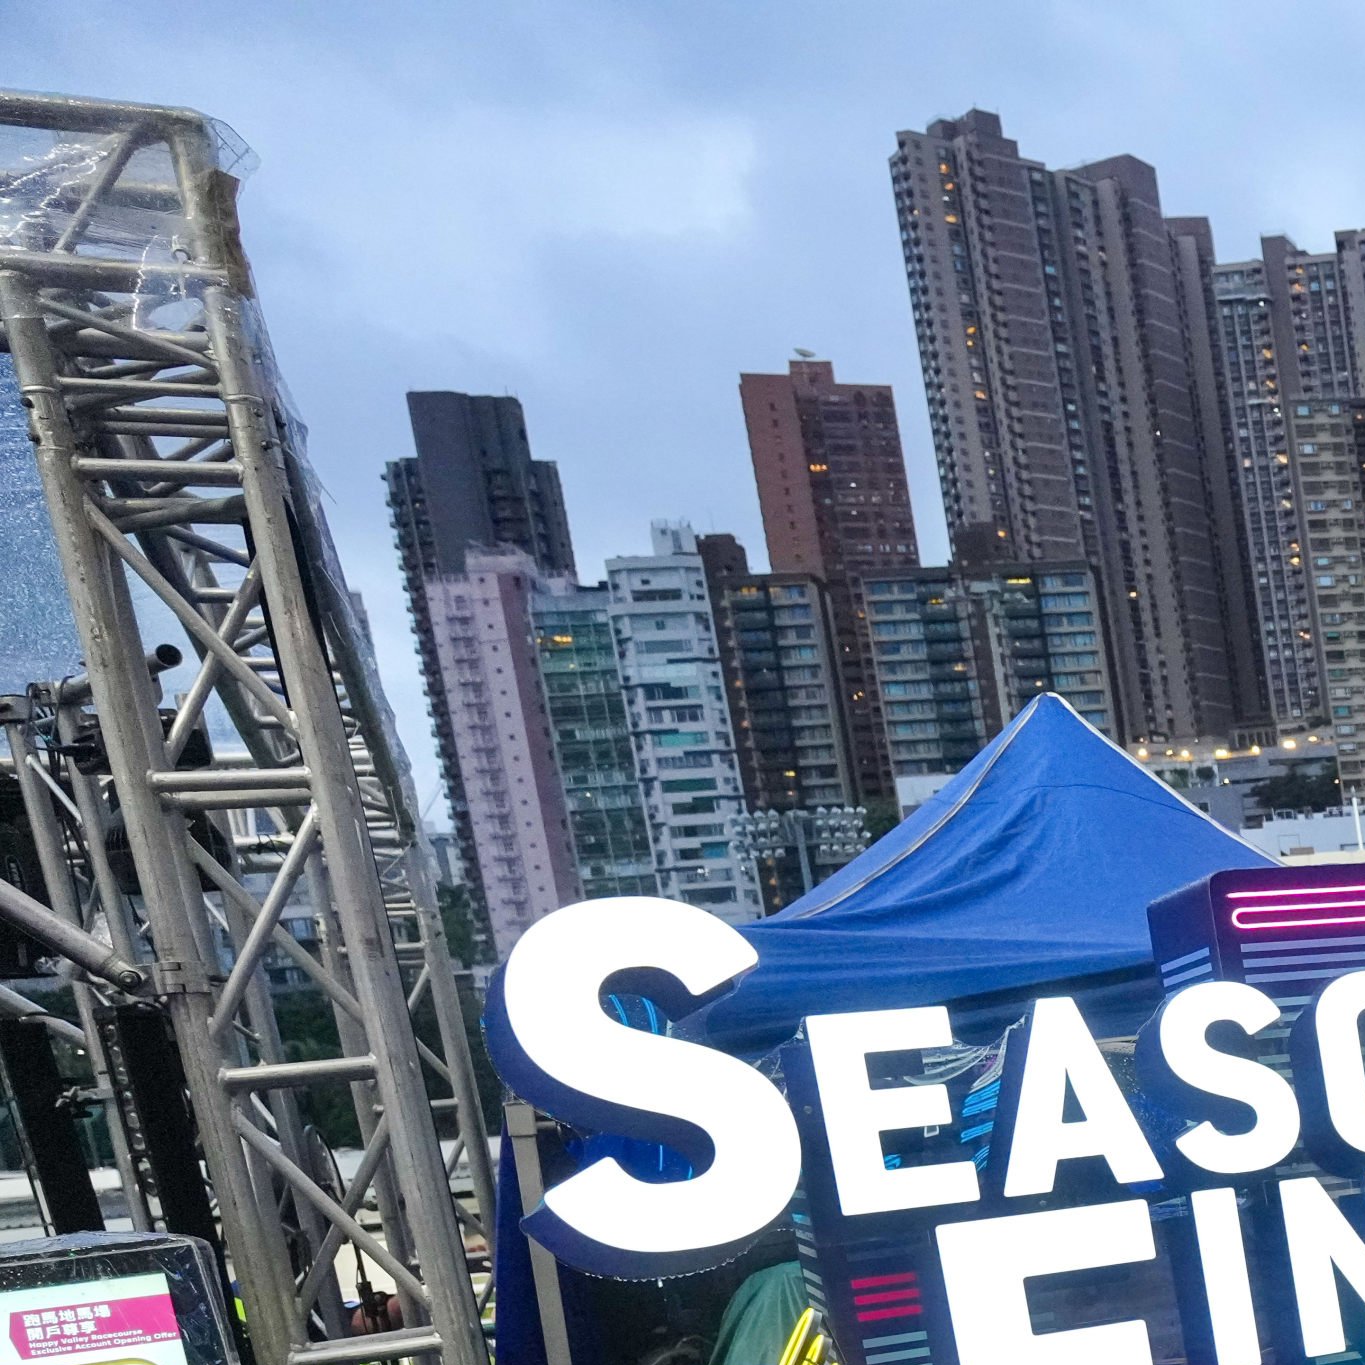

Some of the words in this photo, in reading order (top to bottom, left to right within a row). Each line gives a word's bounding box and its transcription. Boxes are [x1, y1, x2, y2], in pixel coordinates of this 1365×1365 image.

[23, 1305, 111, 1327] 跑馬地馬場
[29, 1339, 58, 1349] Happy
[61, 1336, 89, 1345] Valley
[91, 1329, 143, 1341] Racecourse
[31, 1345, 72, 1356] Exclusive
[76, 1340, 111, 1350] Account
[114, 1335, 152, 1346] Opening
[154, 1331, 177, 1340] Offer
